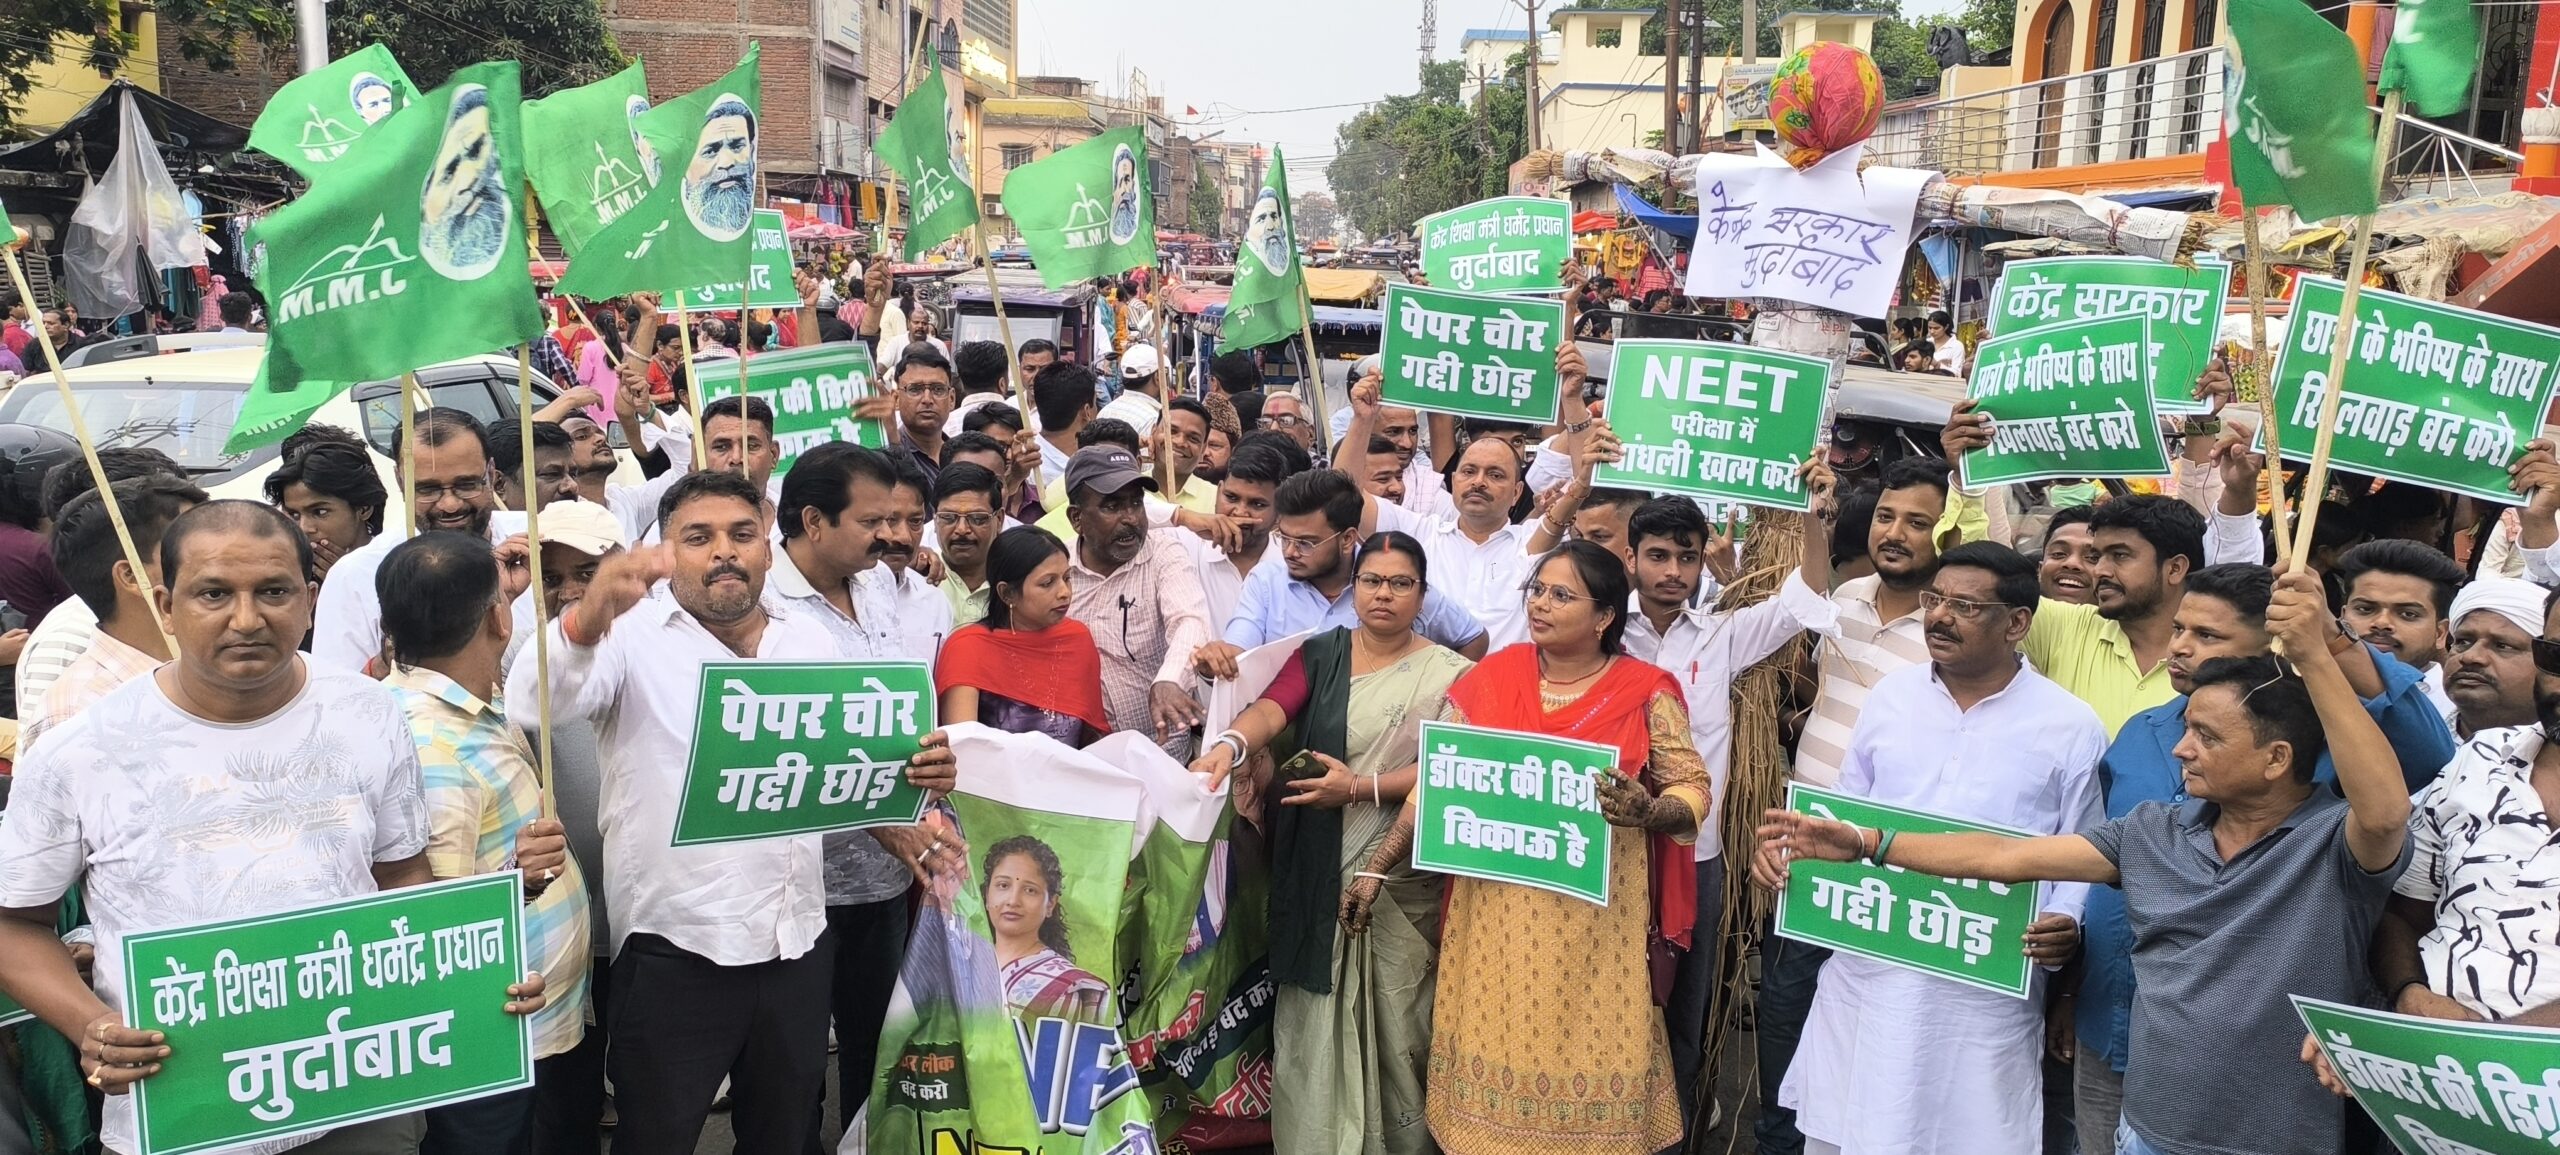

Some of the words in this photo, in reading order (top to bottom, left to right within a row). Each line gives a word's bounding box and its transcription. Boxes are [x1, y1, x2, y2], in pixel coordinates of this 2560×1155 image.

[1450, 218, 1476, 245] शिक्षा
[1478, 210, 1500, 240] मंत्री
[1534, 213, 1564, 238] प्रधान
[1763, 206, 1896, 265] सरकार
[1449, 242, 1542, 291] मुर्दाबाद
[1400, 295, 1476, 346] पेपर
[1482, 308, 1549, 353] चोर
[2007, 271, 2067, 321] केंद्र
[2073, 283, 2210, 326] सरकार
[1401, 350, 1465, 392] गद्दी
[1470, 354, 1537, 408] छोड़
[1640, 354, 1799, 414] NEET
[2003, 347, 2024, 394] के
[2023, 342, 2075, 394] भविष्य
[2077, 335, 2097, 387] के
[2098, 341, 2139, 385] साथ
[2359, 309, 2390, 365] के
[2389, 320, 2464, 384] भविष्य
[2460, 332, 2493, 389] के
[2489, 351, 2548, 402] साथ
[779, 374, 815, 417] की
[1670, 410, 1735, 441] परीक्षा
[1739, 415, 1760, 444] में
[2060, 400, 2098, 456] बंद
[2094, 396, 2142, 450] करो
[2416, 396, 2465, 457] बंद
[2462, 410, 2517, 469] करो
[1698, 450, 1760, 487] खत्म
[1761, 452, 1801, 494] करो
[720, 678, 834, 742] पेपर
[841, 676, 920, 738] चोर
[716, 751, 814, 813] गद्दी
[818, 747, 908, 811] छोड़
[1428, 742, 1507, 796] डॉक्टर
[1508, 754, 1547, 802] की
[1442, 804, 1561, 862] बिकाऊ
[1557, 820, 1591, 869] है
[1811, 875, 1898, 934] गद्दी
[1906, 889, 2000, 966] छोड़
[149, 956, 207, 1027] केंद्र
[212, 947, 288, 1018] शिक्षा
[294, 928, 354, 1001] मंत्री
[361, 915, 427, 988] धर्मेंद्र
[431, 916, 506, 982] प्रधान
[223, 1006, 456, 1123] मुर्दाबाद
[898, 1075, 917, 1100] बंद
[918, 1078, 949, 1101] करो
[921, 1052, 956, 1074] लीक
[2325, 1028, 2442, 1111] डॉक्टर
[2420, 1054, 2495, 1127] की
